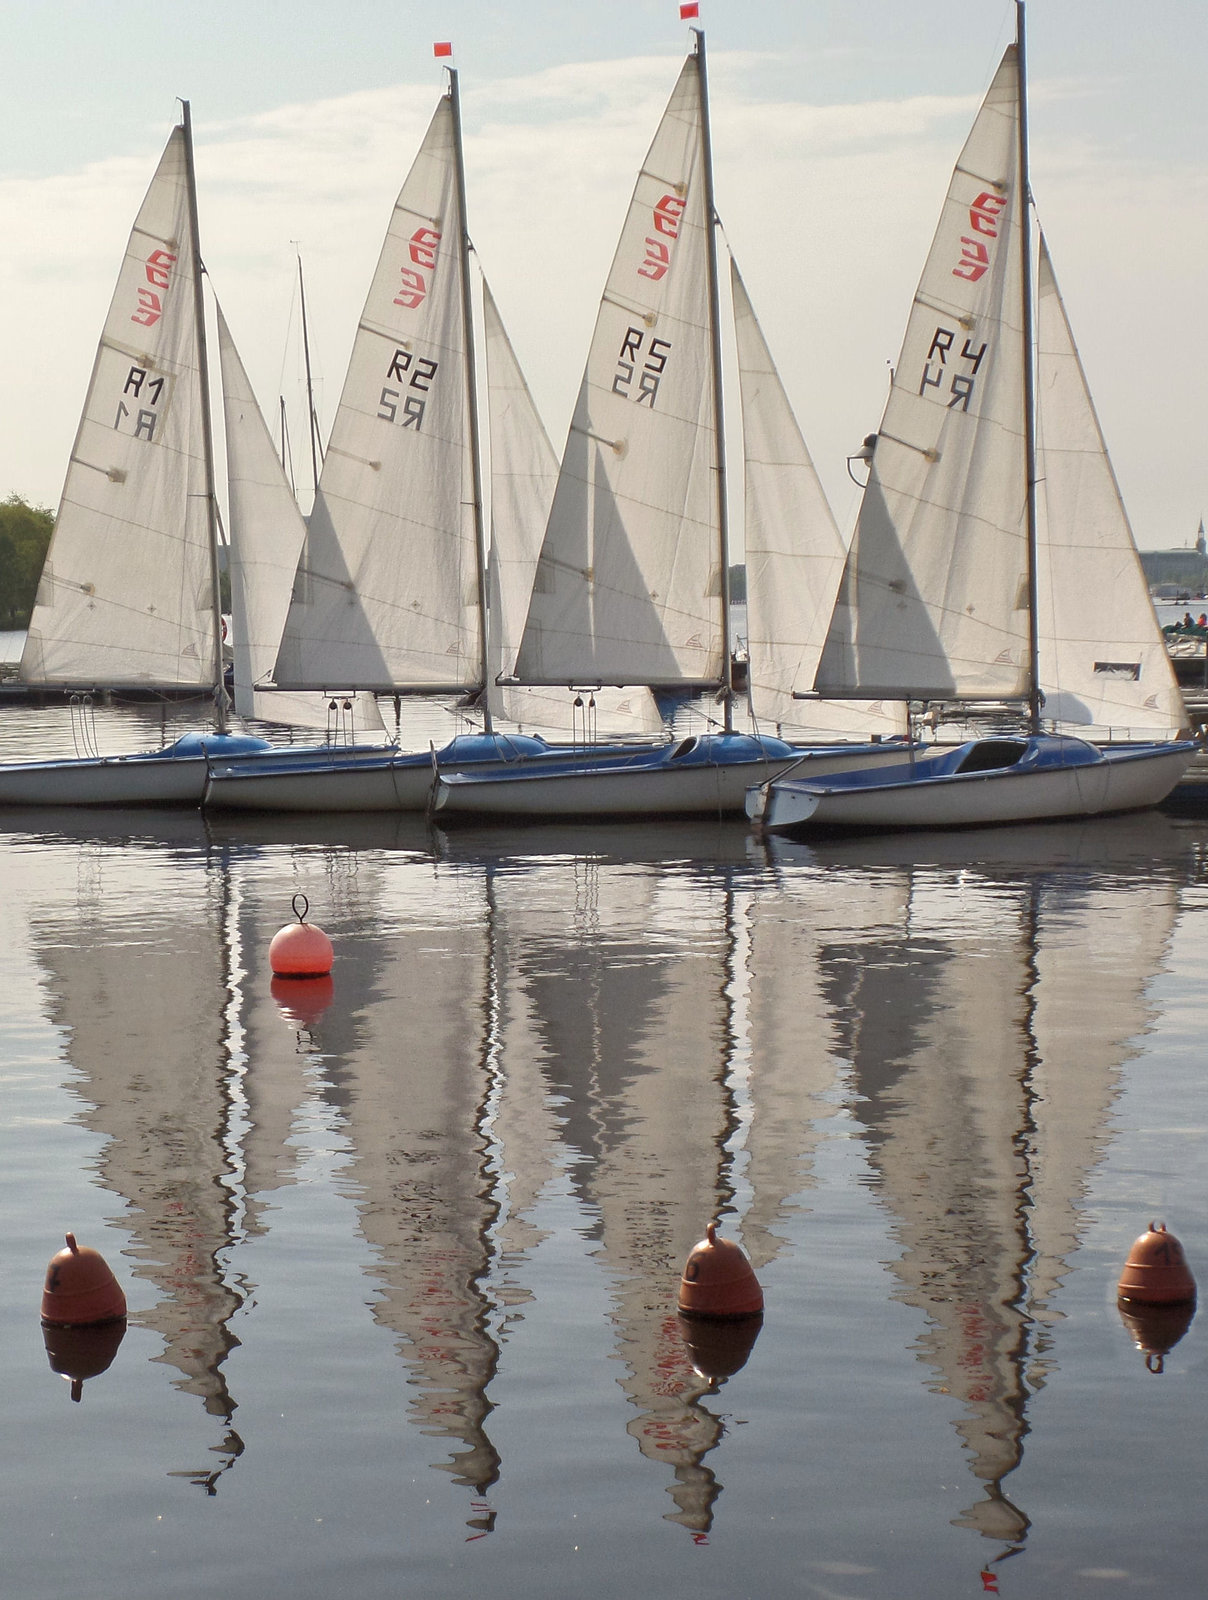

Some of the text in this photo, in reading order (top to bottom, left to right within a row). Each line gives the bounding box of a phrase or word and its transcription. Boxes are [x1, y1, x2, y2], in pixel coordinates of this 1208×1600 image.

[386, 349, 439, 391] R2
[619, 326, 672, 374] R5
[927, 326, 988, 375] R4
[123, 365, 165, 406] R1
